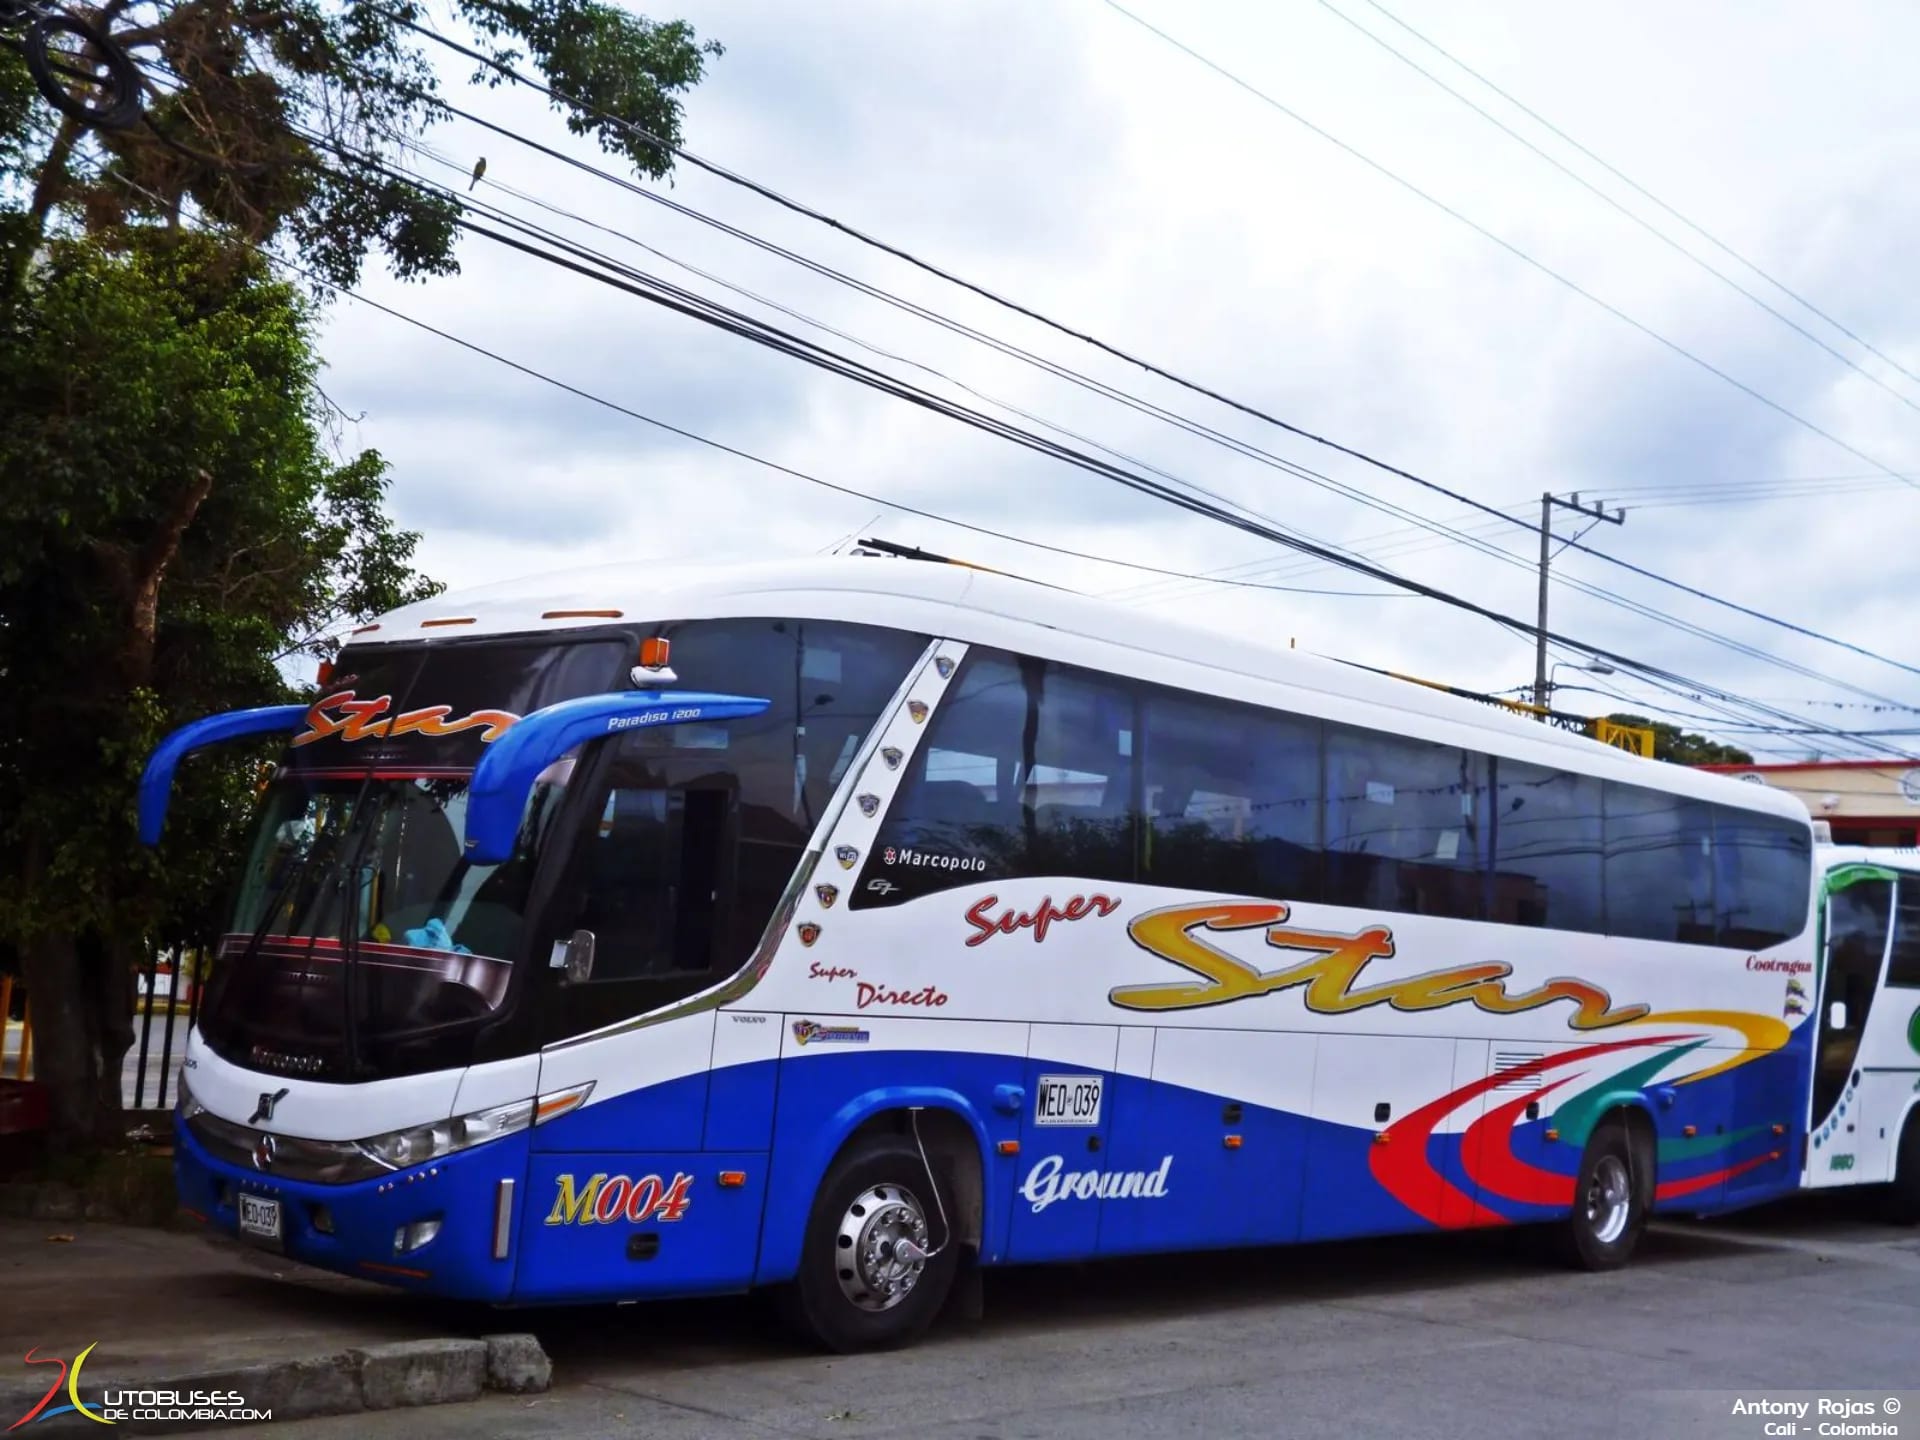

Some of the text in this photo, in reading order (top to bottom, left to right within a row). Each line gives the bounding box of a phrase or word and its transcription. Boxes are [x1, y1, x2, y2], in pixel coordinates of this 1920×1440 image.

[607, 708, 702, 730] Paradiso 1200
[898, 848, 986, 871] Marcopolo
[808, 961, 858, 983] Super
[964, 892, 1651, 1031] Super Star
[856, 981, 948, 1009] Directo
[731, 1015, 767, 1024] VOLVO
[1018, 1154, 1174, 1213] Ground
[543, 1171, 695, 1227] M004
